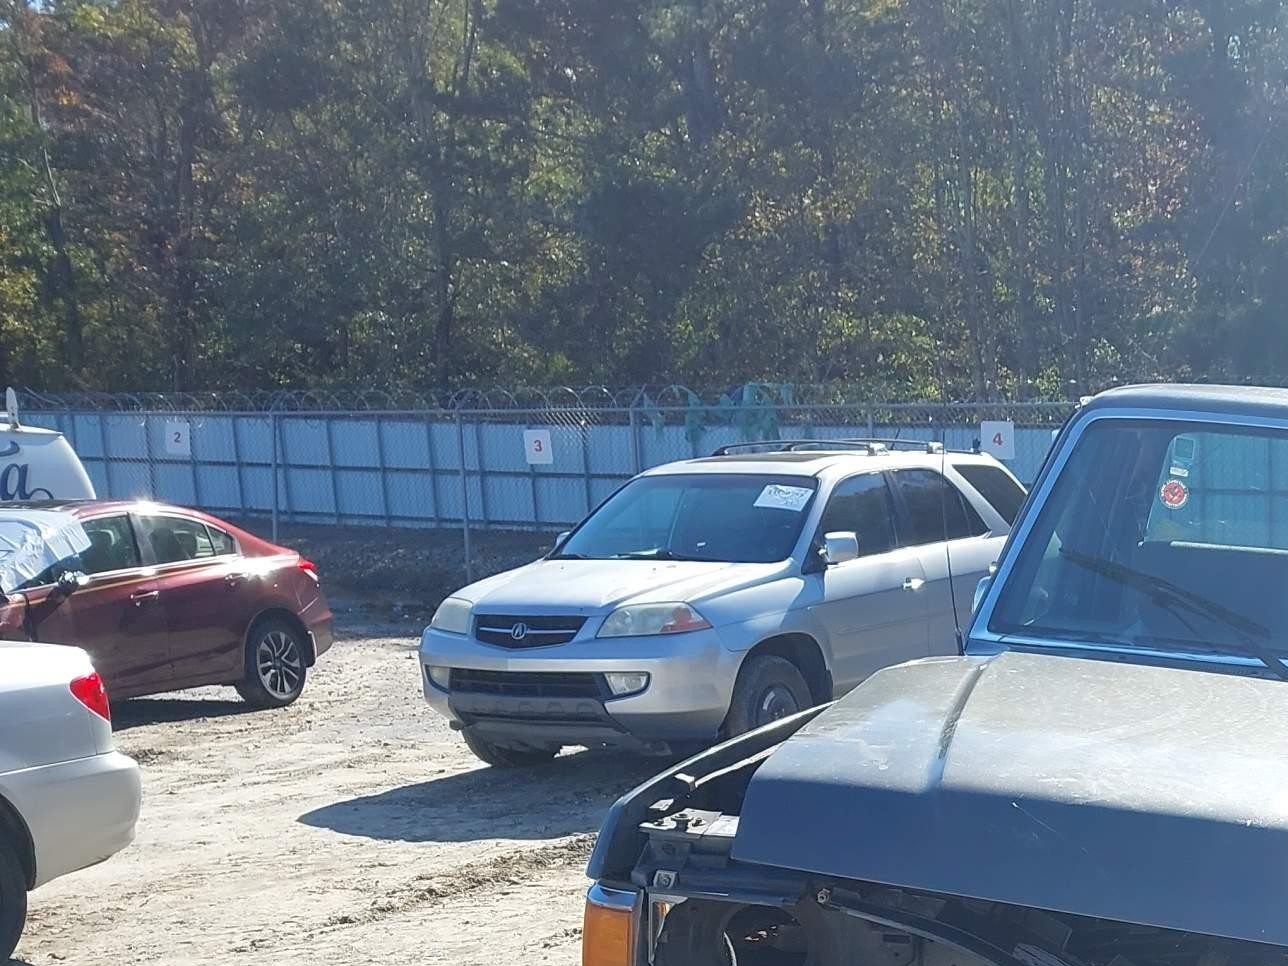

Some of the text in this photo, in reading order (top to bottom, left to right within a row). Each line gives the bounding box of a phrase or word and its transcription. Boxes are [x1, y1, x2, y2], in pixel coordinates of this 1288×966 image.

[173, 431, 182, 443] 2
[992, 432, 1003, 446] 4
[534, 439, 543, 452] 3
